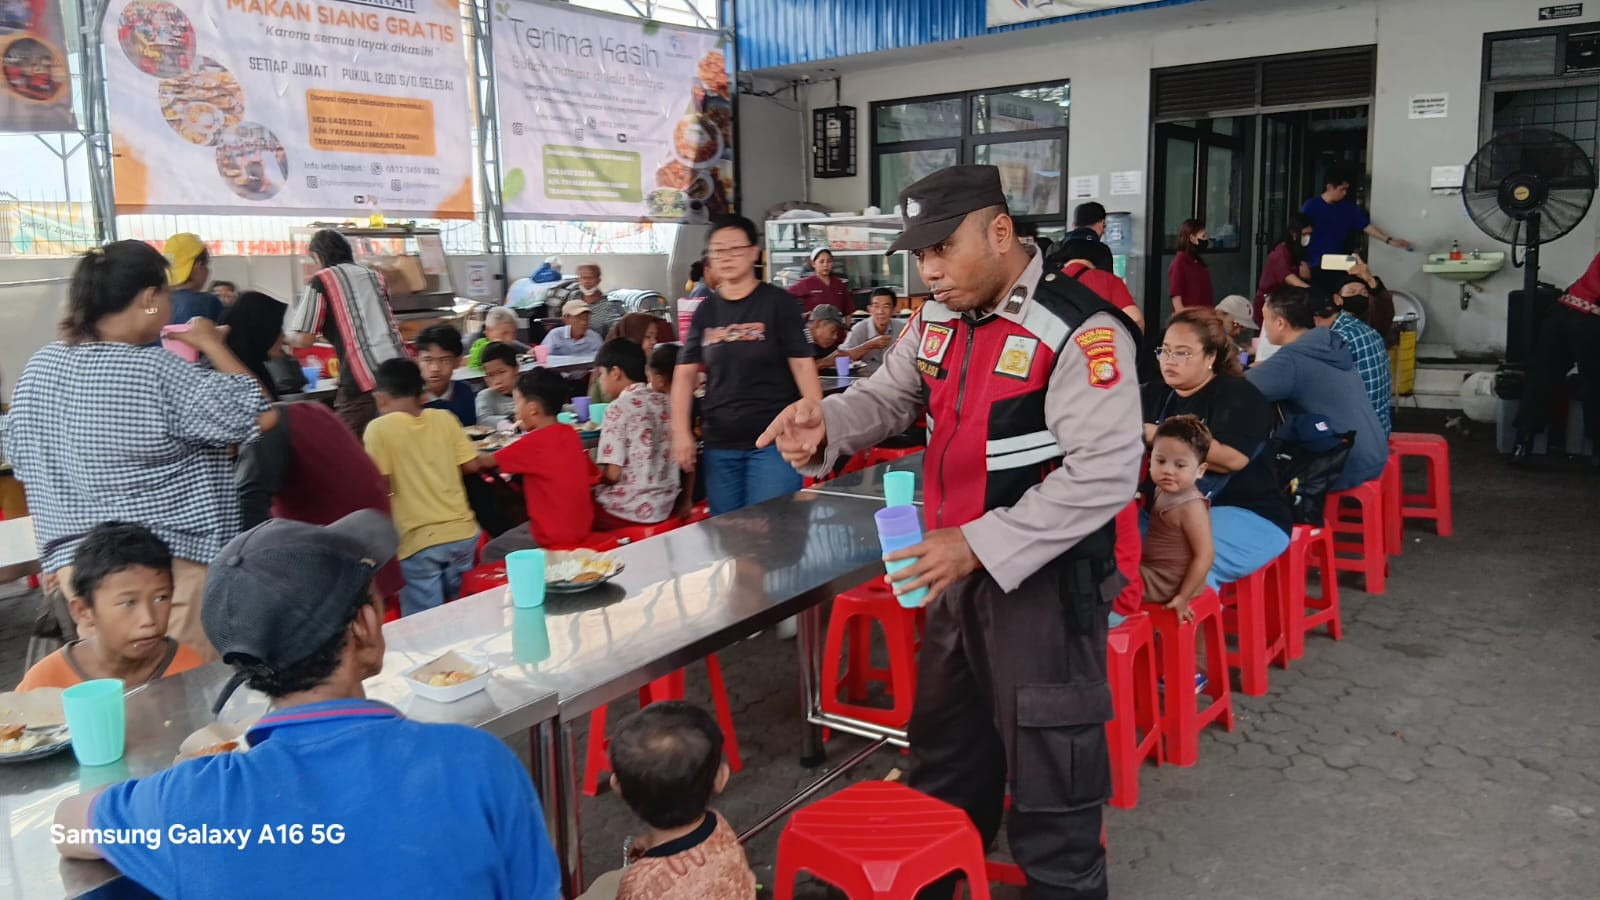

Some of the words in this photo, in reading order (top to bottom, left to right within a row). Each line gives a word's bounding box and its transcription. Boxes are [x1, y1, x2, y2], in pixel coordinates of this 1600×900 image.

[226, 0, 311, 22] MAKAN
[317, 6, 379, 32] SIANG
[386, 16, 454, 43] GRATIS
[265, 25, 310, 42] Karena
[314, 33, 355, 47] semua
[357, 37, 389, 53] layak
[508, 17, 593, 59] Terima
[600, 35, 660, 68] Kasih
[249, 57, 289, 73] SETIAP
[292, 63, 328, 79] JUMAT
[342, 68, 372, 83] PUKUL
[419, 77, 454, 92] SELESAI
[917, 359, 939, 377] POLISI
